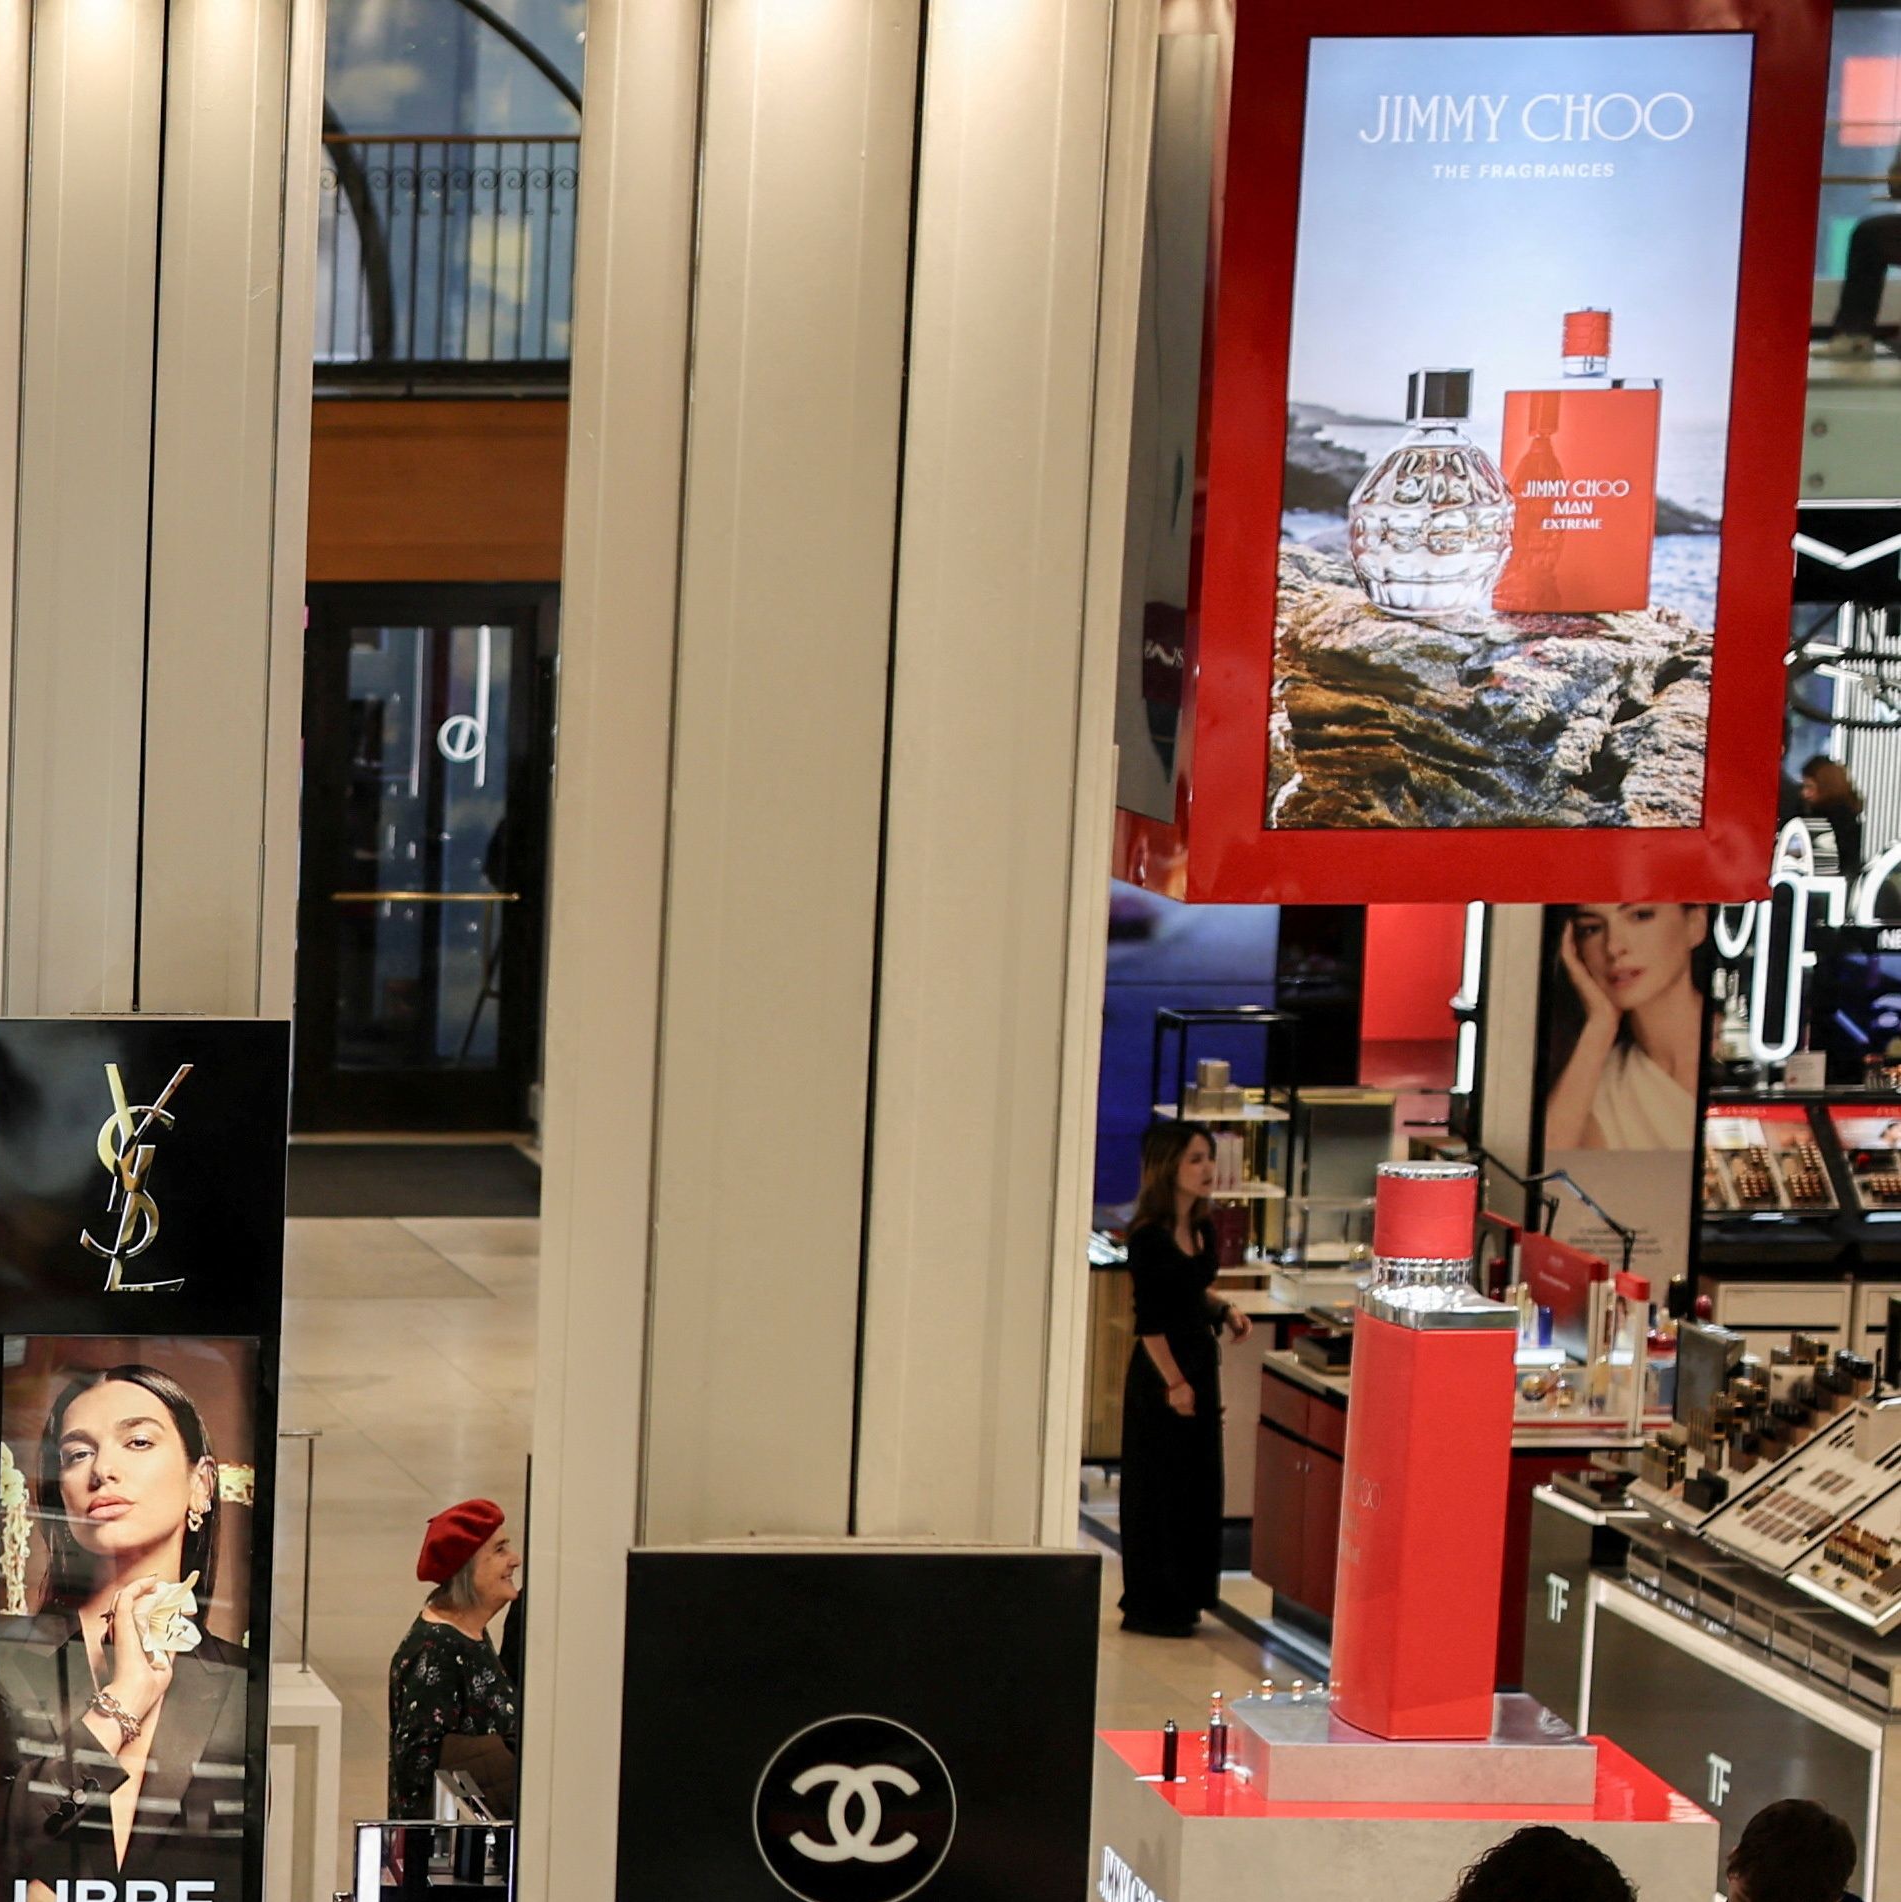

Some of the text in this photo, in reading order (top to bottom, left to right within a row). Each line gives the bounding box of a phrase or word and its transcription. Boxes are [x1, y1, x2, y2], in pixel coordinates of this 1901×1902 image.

[1359, 91, 1695, 144] JIMMY CHOO
[1432, 162, 1616, 180] THE FRAGRANCES
[1520, 478, 1630, 498] JIMMY CHOO
[1552, 500, 1594, 515] MAN
[1541, 517, 1603, 531] EXTREME
[1706, 1751, 1733, 1807] TF
